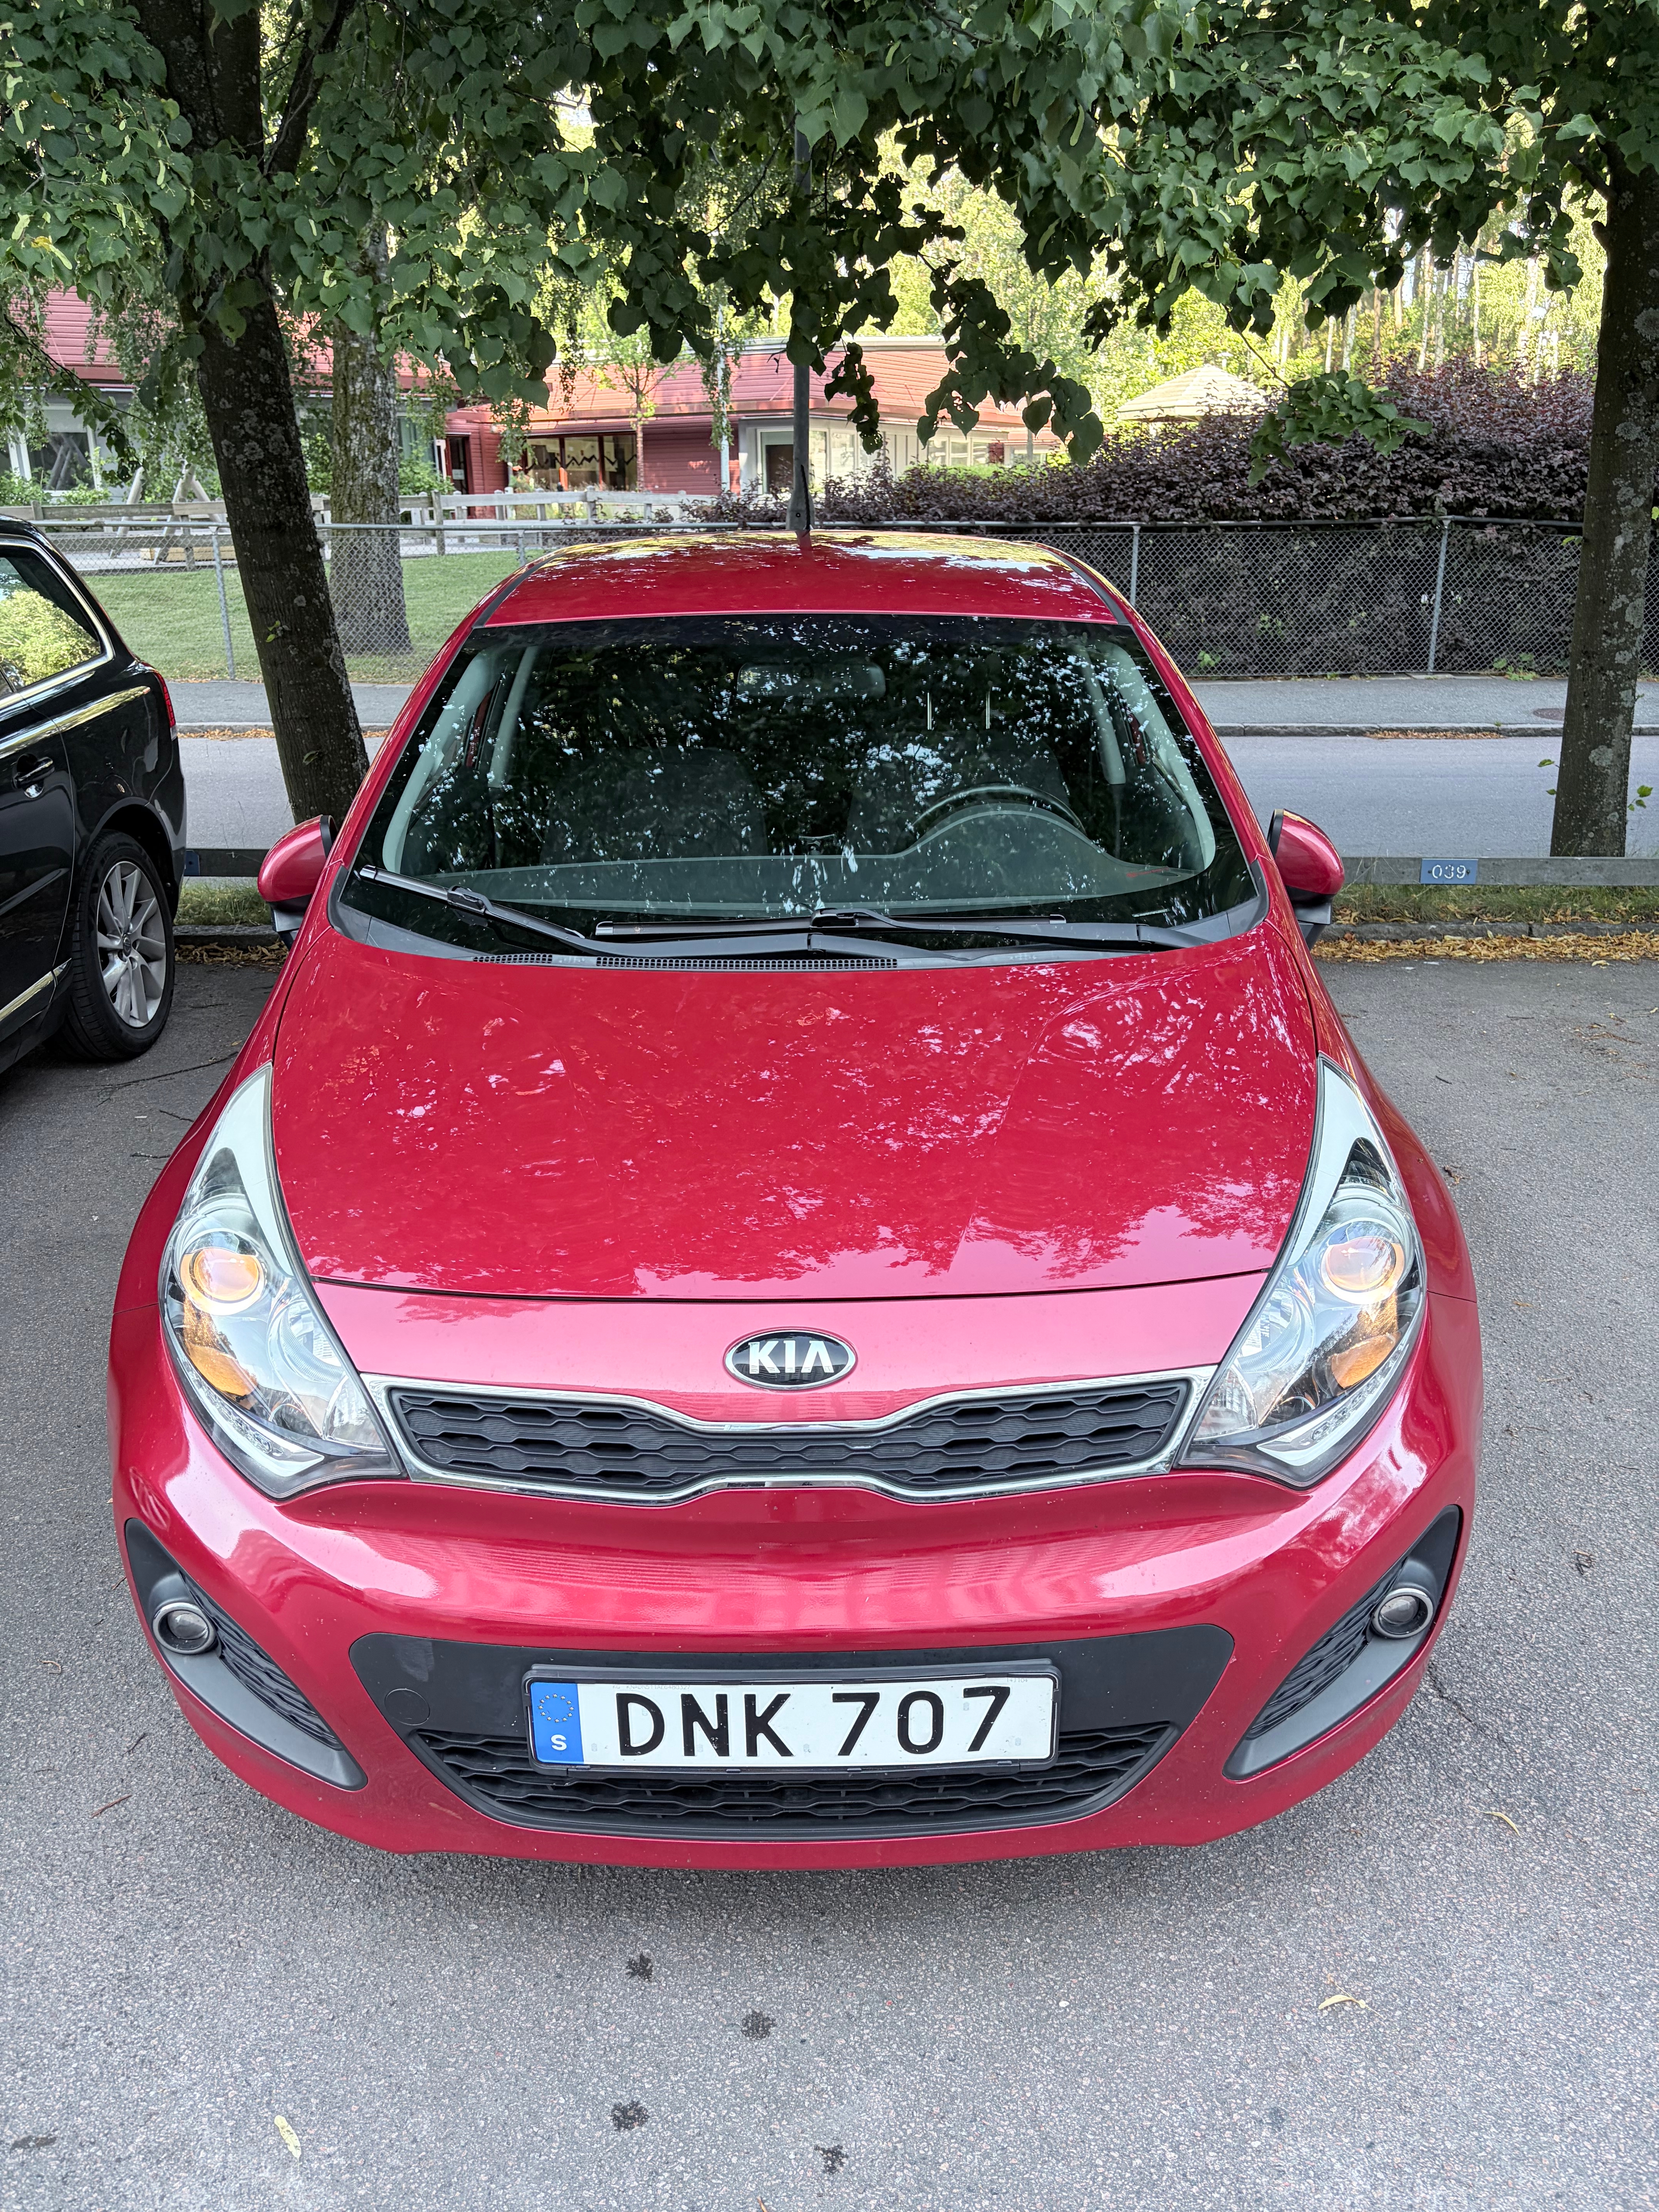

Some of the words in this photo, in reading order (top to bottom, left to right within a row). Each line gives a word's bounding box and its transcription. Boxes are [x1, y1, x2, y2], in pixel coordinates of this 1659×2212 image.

[1432, 864, 1466, 879] 039
[748, 1340, 834, 1374] KIA
[616, 1693, 794, 1757] DNK
[832, 1686, 1010, 1756] 707
[551, 1734, 567, 1750] S
